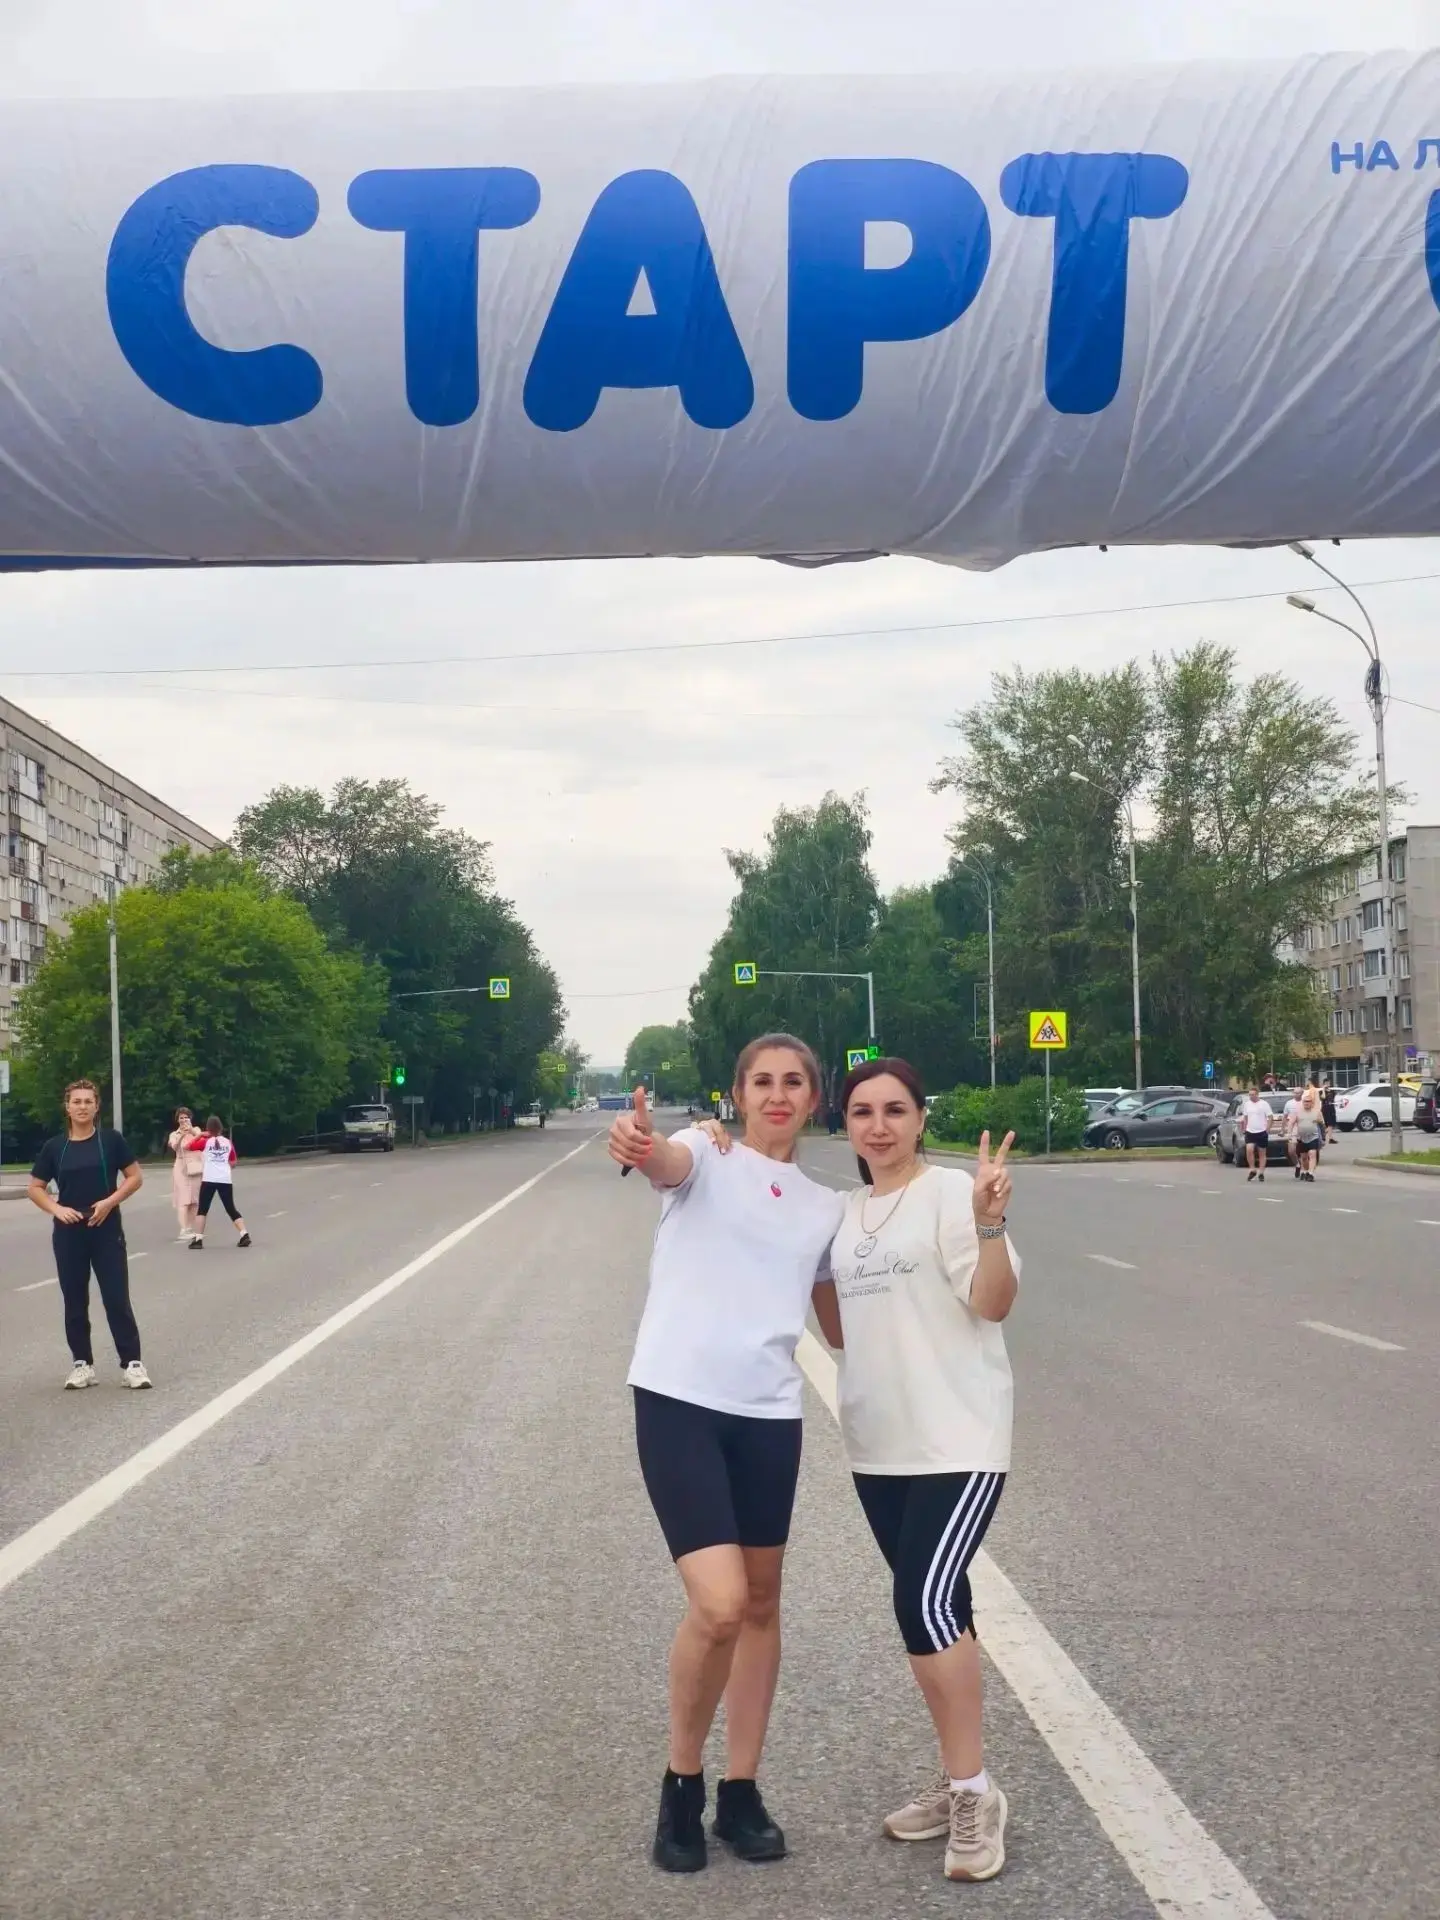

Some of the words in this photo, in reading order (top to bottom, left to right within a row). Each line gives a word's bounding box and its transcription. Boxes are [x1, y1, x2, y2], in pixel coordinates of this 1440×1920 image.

[1331, 140, 1399, 174] НА
[106, 153, 1189, 432] СТАРТ
[888, 1255, 919, 1275] Club
